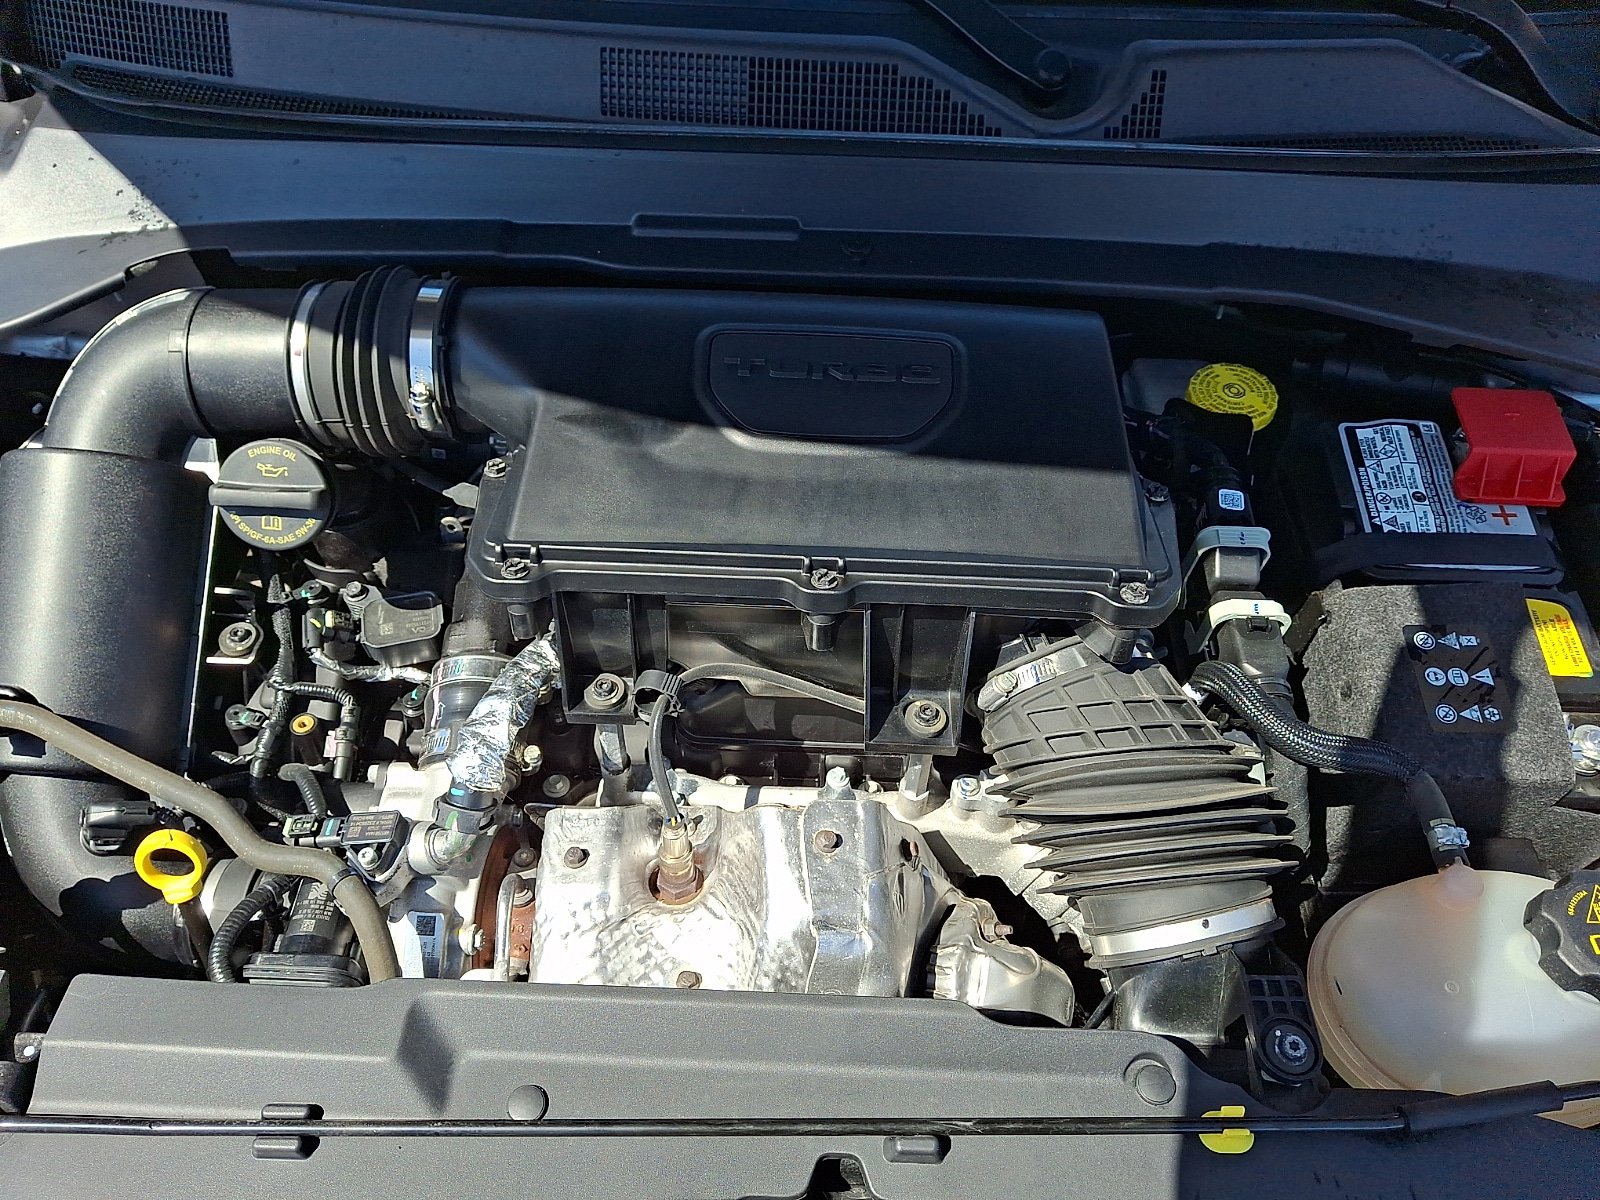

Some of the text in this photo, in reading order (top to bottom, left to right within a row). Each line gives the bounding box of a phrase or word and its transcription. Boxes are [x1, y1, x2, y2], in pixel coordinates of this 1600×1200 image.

[724, 357, 941, 384] TURBO
[247, 446, 297, 462] ENGINE OIL
[1358, 467, 1378, 516] DANGER/POISON
